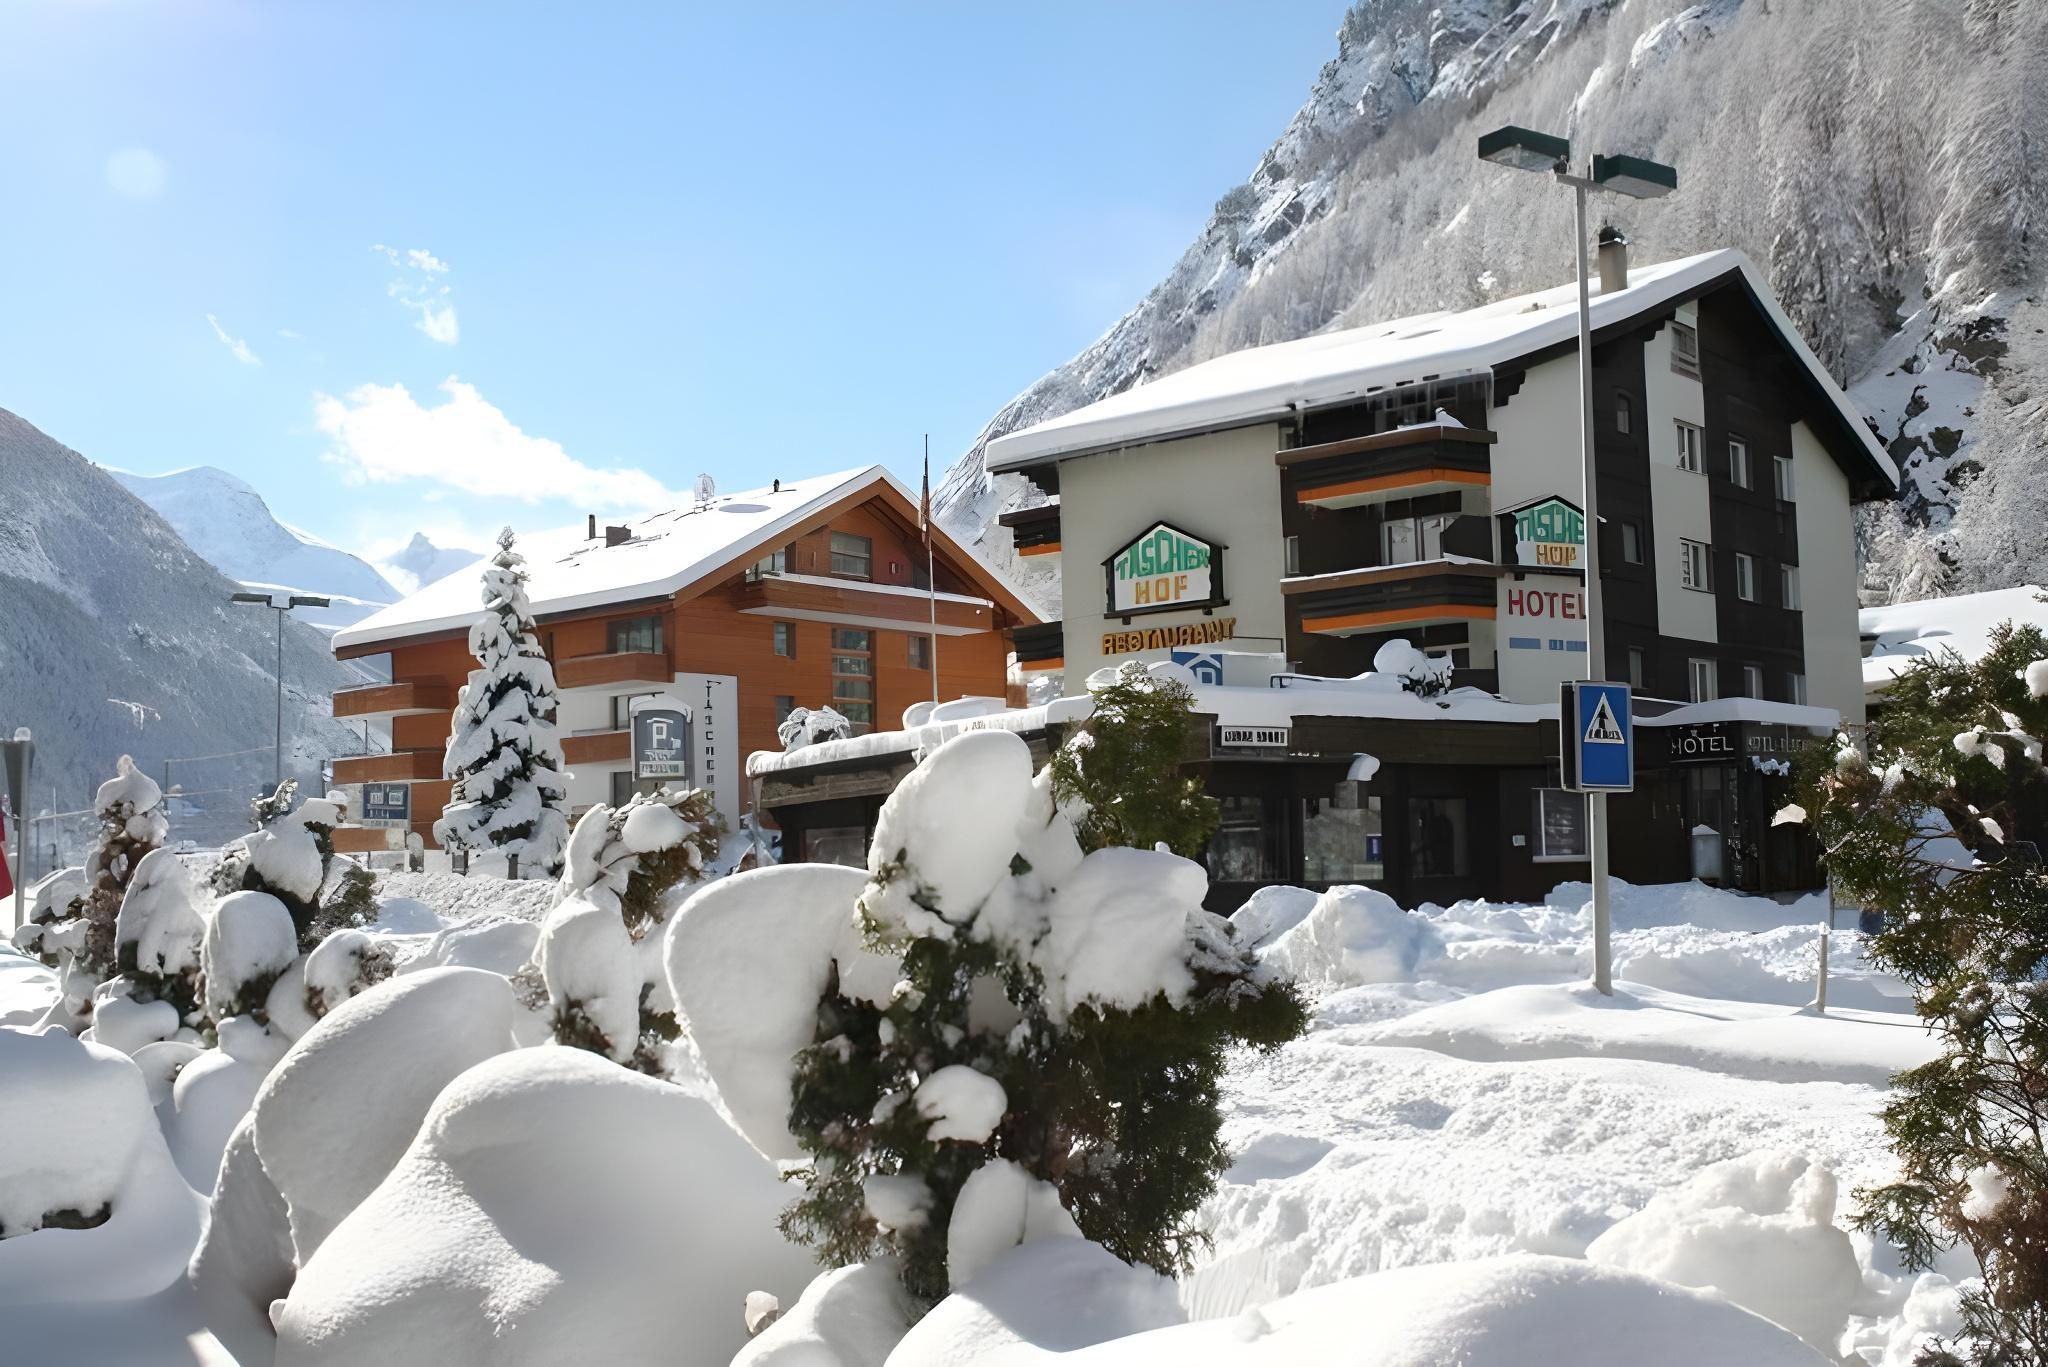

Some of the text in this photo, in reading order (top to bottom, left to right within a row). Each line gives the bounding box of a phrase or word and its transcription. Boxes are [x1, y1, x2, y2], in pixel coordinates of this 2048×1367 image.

[1515, 503, 1585, 545] TASCHE
[1135, 574, 1188, 605] HOF
[1508, 588, 1587, 620] HOTEL
[1671, 736, 1734, 755] HOTEL
